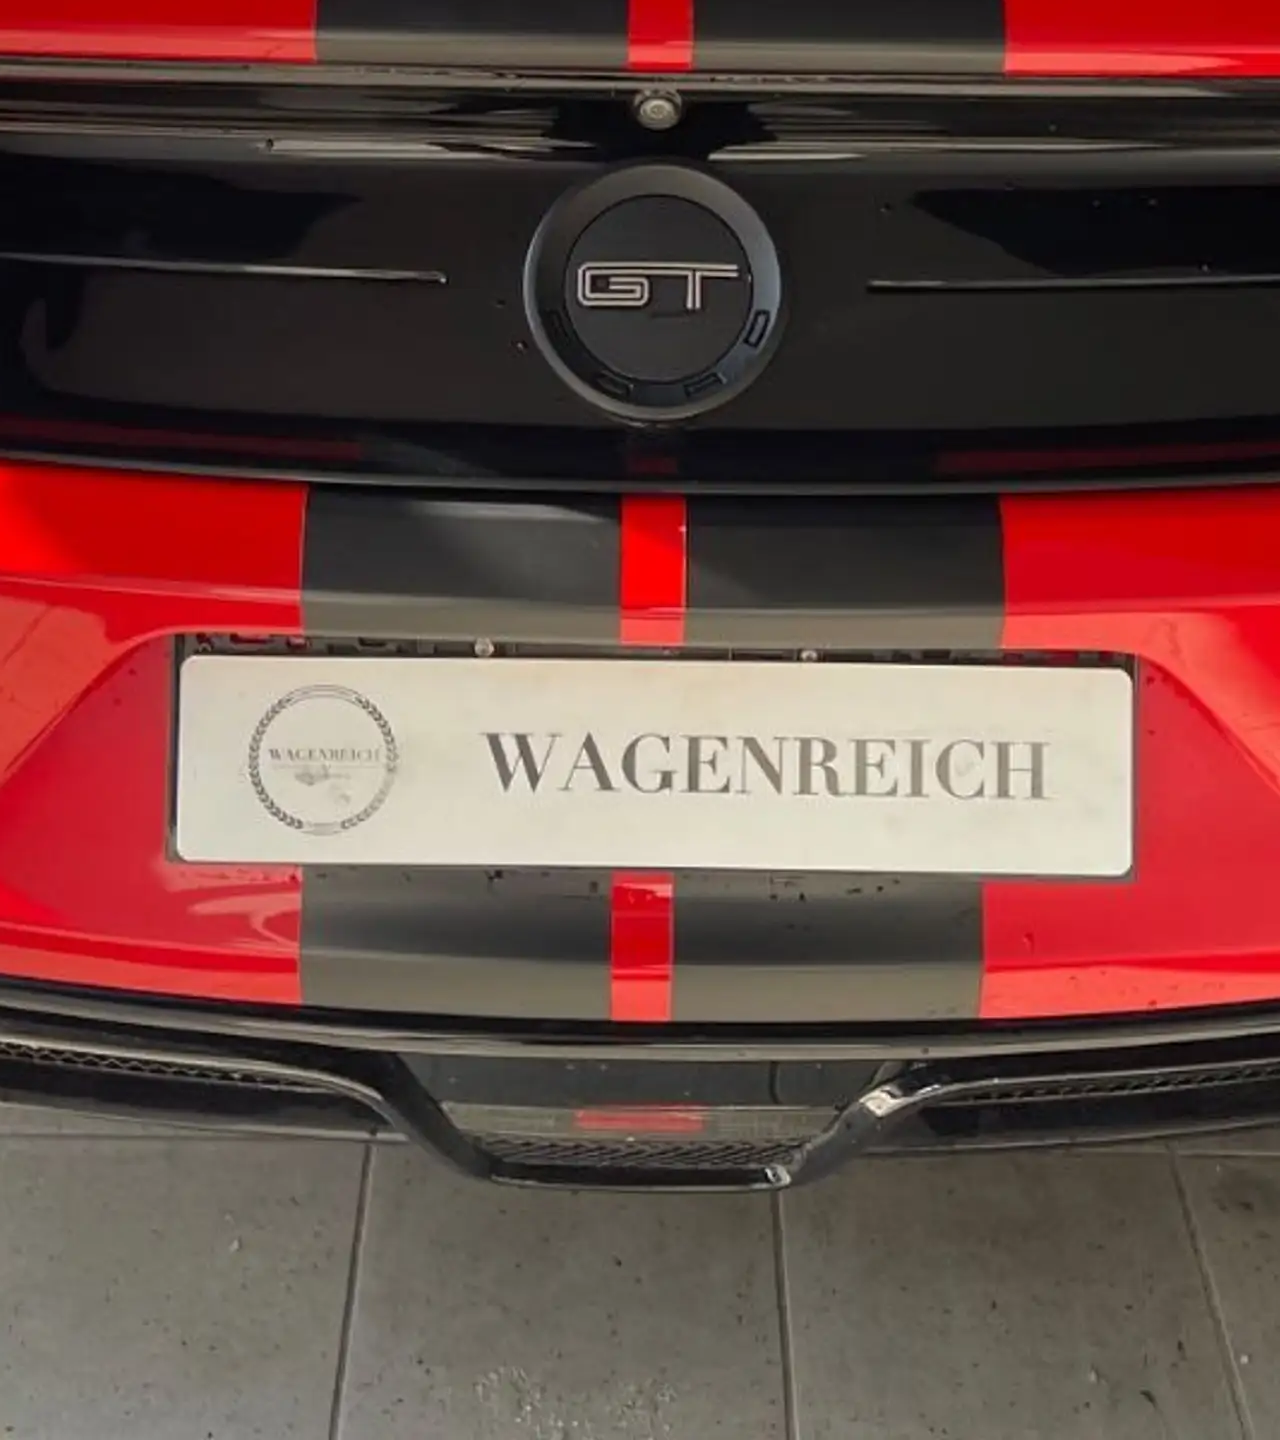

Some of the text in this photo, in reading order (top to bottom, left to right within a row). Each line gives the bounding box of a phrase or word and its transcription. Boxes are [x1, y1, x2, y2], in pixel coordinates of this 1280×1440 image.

[577, 262, 739, 310] GT
[269, 747, 380, 762] WAGENREICH
[481, 731, 1051, 800] WAGENREICH
